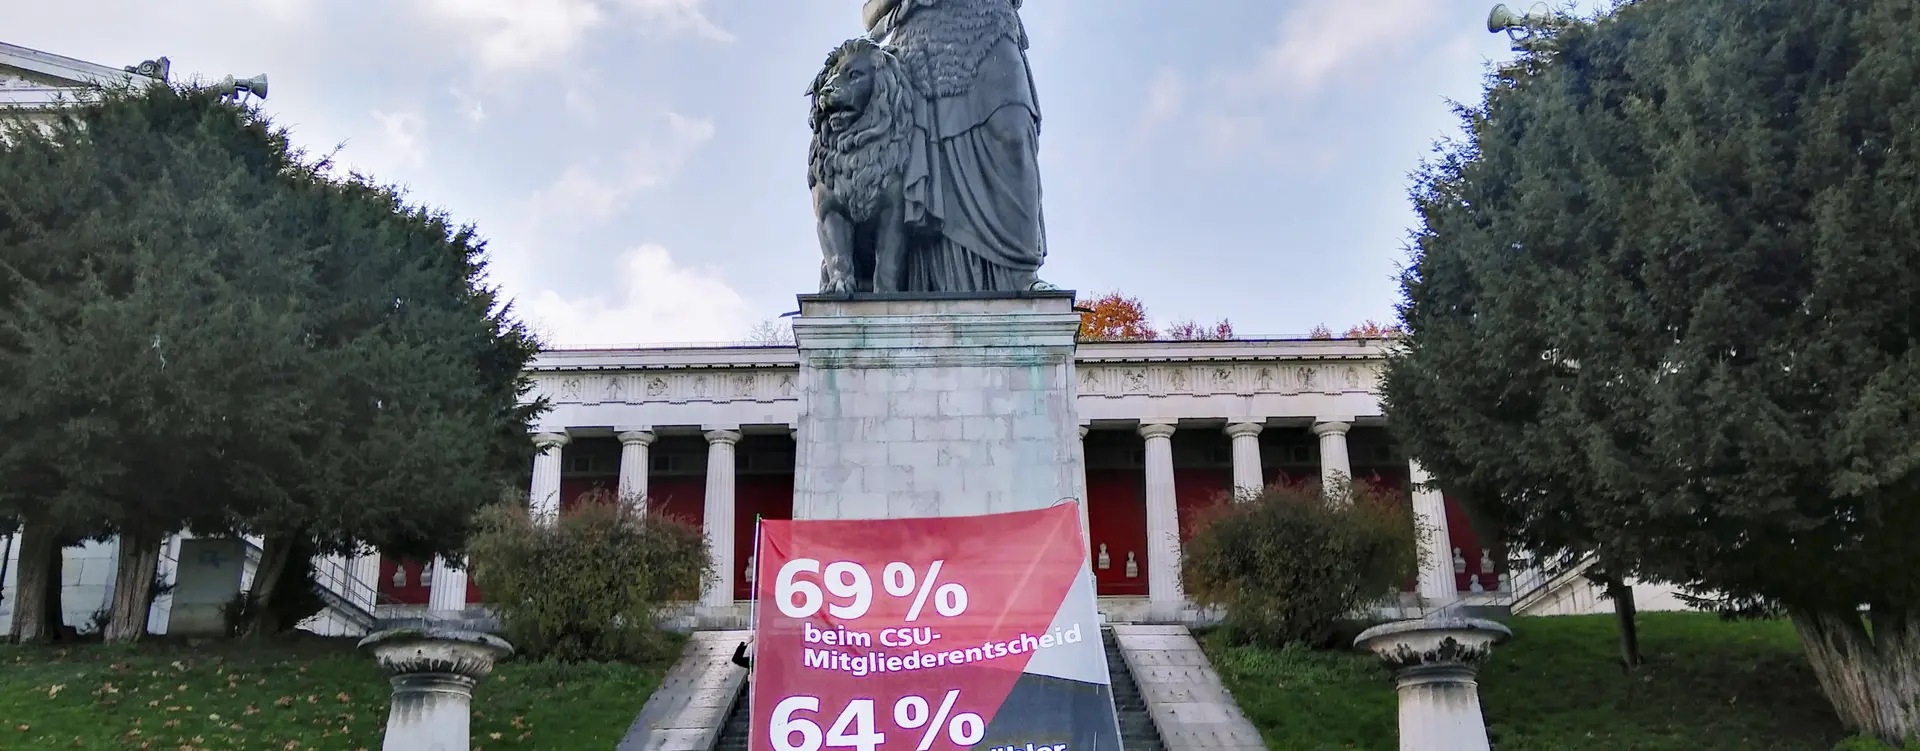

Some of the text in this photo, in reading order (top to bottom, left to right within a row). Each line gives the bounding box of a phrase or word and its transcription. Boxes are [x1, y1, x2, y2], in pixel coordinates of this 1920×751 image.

[803, 622, 942, 648] beim CSU-
[803, 623, 1083, 677] Mitgliederentscheid
